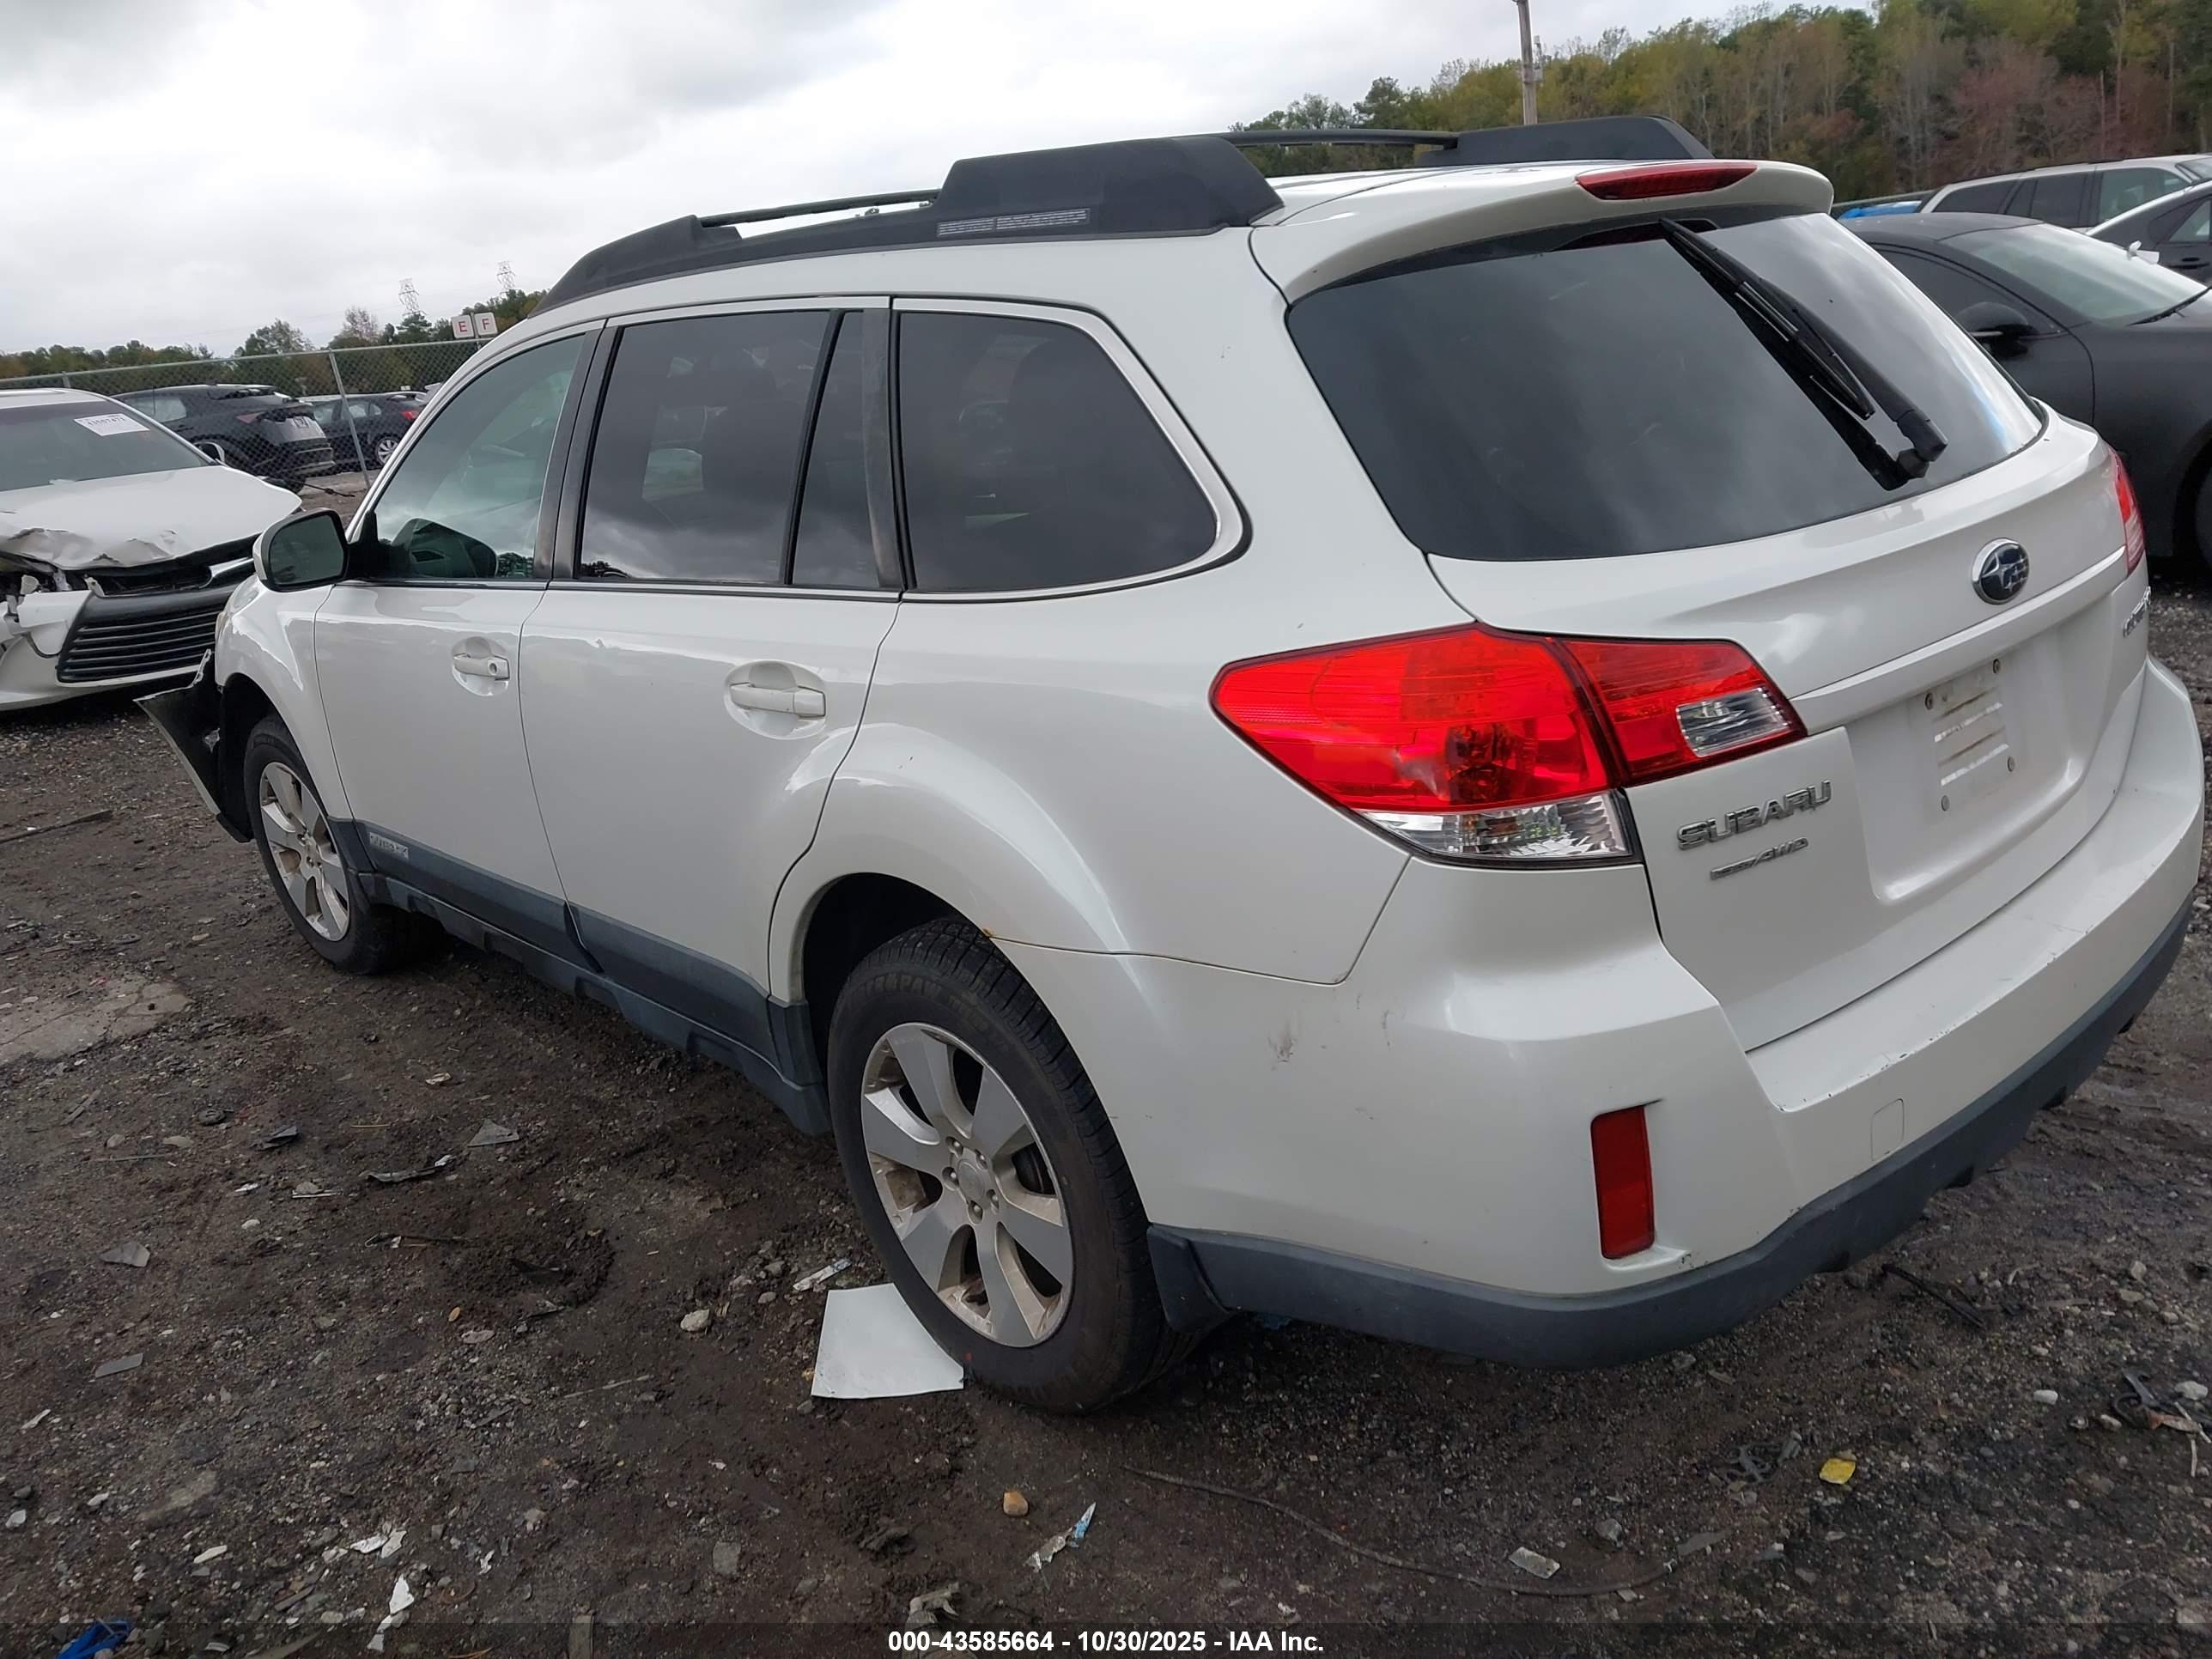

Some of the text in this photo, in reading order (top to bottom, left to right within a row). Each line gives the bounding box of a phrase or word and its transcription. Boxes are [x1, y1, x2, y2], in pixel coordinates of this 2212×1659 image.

[458, 320, 468, 333] E
[481, 318, 490, 331] F
[1677, 780, 1832, 850] SUBARU
